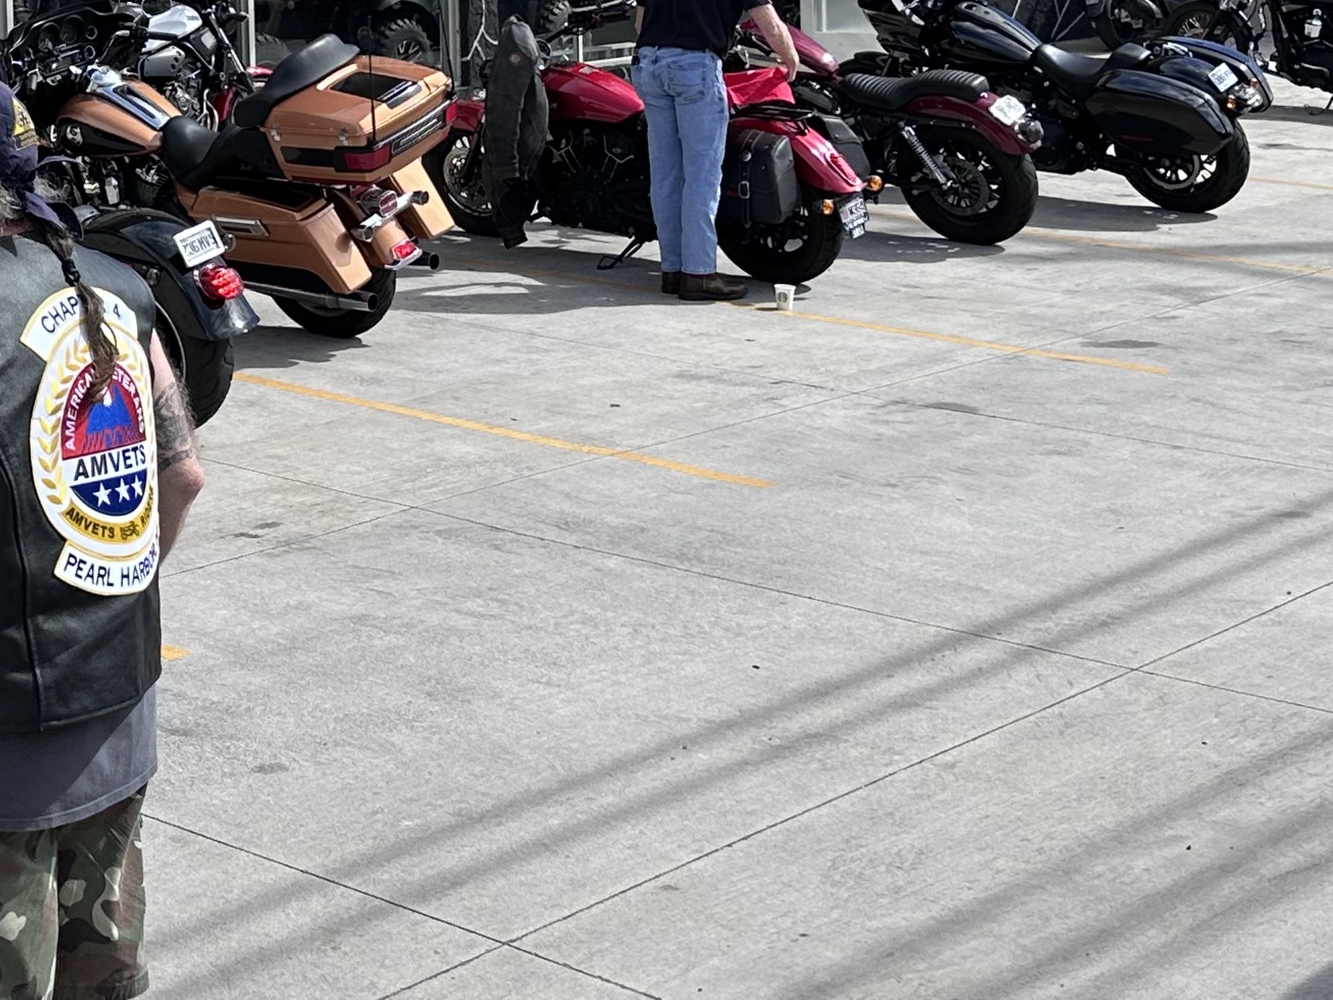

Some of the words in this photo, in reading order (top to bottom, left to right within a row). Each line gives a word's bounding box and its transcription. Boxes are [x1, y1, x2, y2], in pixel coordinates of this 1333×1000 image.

[113, 303, 122, 320] 4
[112, 367, 145, 434] ETERANS
[73, 444, 146, 481] AMVETS
[65, 507, 115, 539] AMVETS
[63, 553, 114, 587] PEARL
